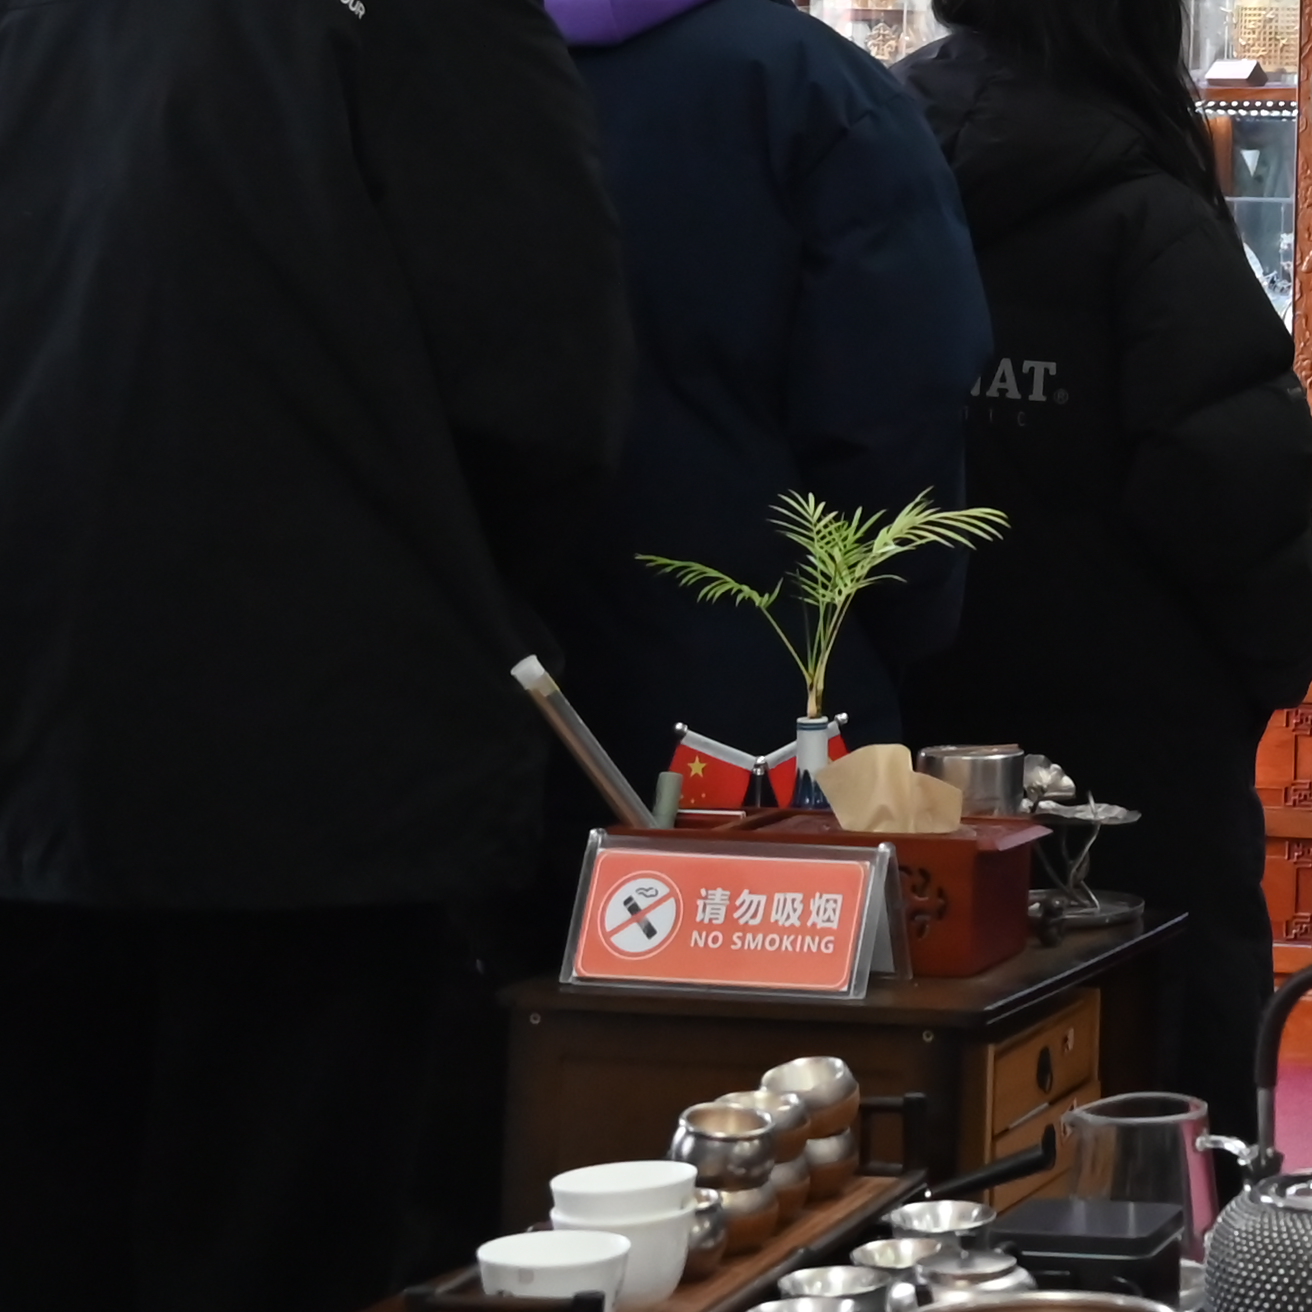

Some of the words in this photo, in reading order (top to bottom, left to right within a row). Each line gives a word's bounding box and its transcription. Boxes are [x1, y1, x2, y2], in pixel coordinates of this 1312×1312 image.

[970, 357, 1057, 402] AT
[696, 887, 843, 929] 请勿吸烟
[690, 930, 724, 949] NO
[731, 931, 835, 954] SMOKING
